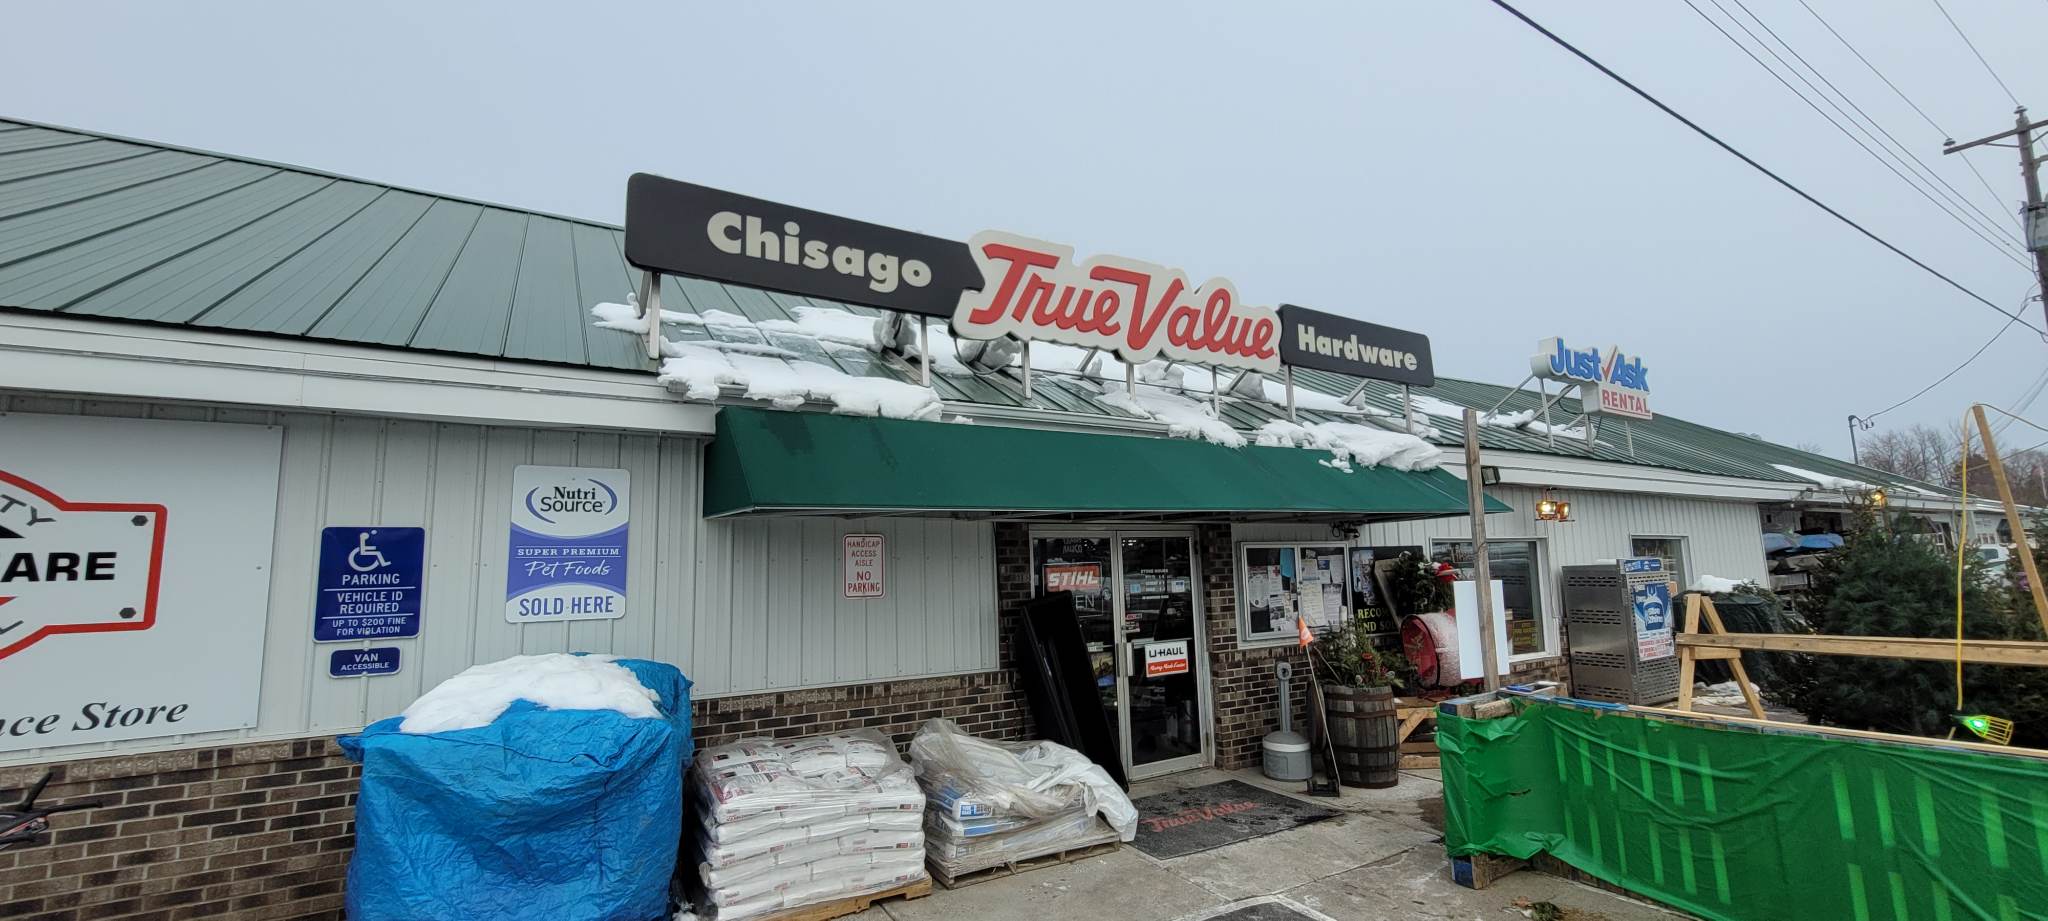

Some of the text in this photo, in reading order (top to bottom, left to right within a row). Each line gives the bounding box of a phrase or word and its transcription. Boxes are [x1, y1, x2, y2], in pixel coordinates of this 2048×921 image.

[707, 211, 932, 293] Chisago
[968, 243, 1275, 359] True Value
[1297, 323, 1418, 371] Hardware
[1550, 338, 1650, 392] Just Ask
[1602, 389, 1651, 413] RENTAL
[553, 486, 596, 500] Nutri
[540, 497, 603, 513] Source
[847, 540, 881, 548] HANDICAP
[517, 548, 619, 556] SUPER PREMIUM
[851, 549, 877, 558] ACCESS
[524, 559, 611, 578] Pet Foods
[855, 559, 873, 567] AISLE
[341, 573, 400, 586] PARKING
[856, 570, 871, 581] NO
[1047, 570, 1098, 587] STIHL
[847, 582, 880, 593] PARKING
[337, 591, 403, 603] VEHICLE ID
[1075, 594, 1095, 609] EN
[339, 602, 400, 614] REQUIRED
[519, 595, 614, 617] SOLD HERE
[332, 616, 407, 628] UP TO $200 FINE
[336, 625, 401, 636] FOR VIOLATION
[354, 653, 379, 663] VAN
[1149, 646, 1185, 658] U-HAUL
[340, 661, 390, 671] ACCESSIBLE
[0, 701, 189, 737] ce Store
